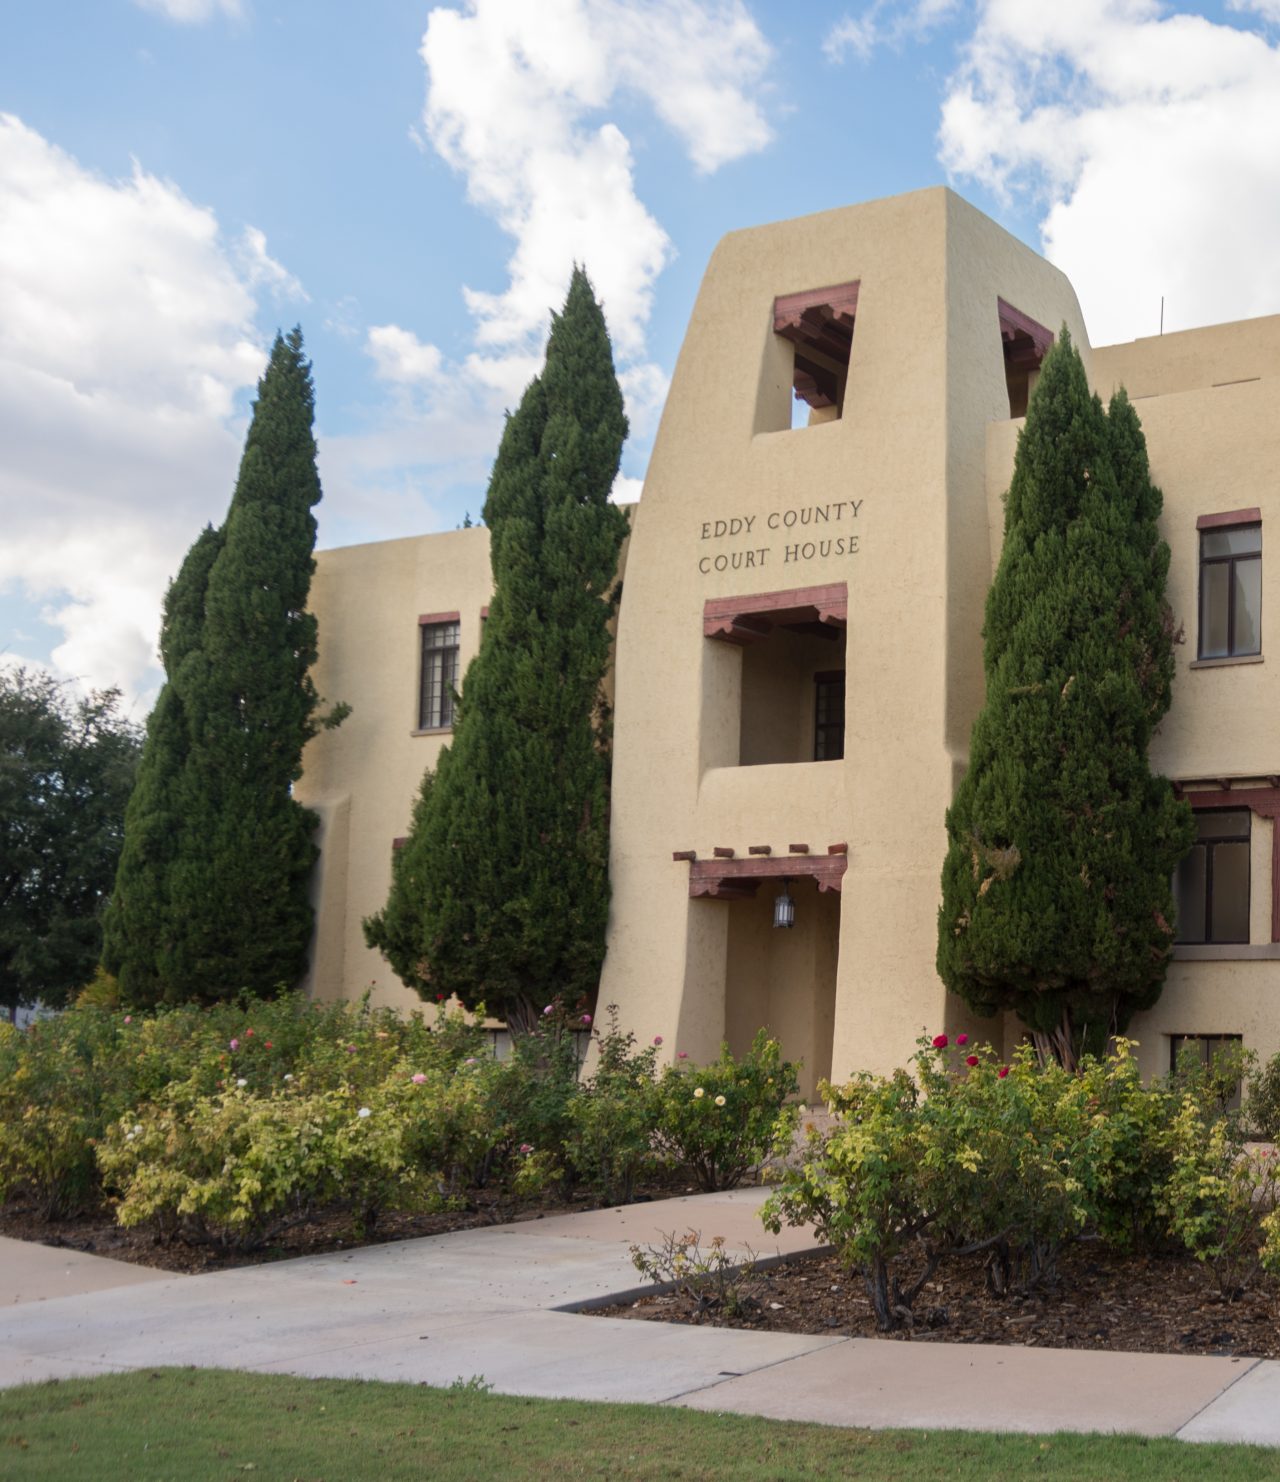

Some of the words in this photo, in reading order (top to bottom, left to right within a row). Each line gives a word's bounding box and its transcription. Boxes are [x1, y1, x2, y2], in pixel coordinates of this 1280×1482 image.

[700, 515, 756, 540] EDDY
[767, 499, 864, 530] COUNTY
[698, 548, 770, 575] COURT
[783, 535, 861, 564] HOUSE
